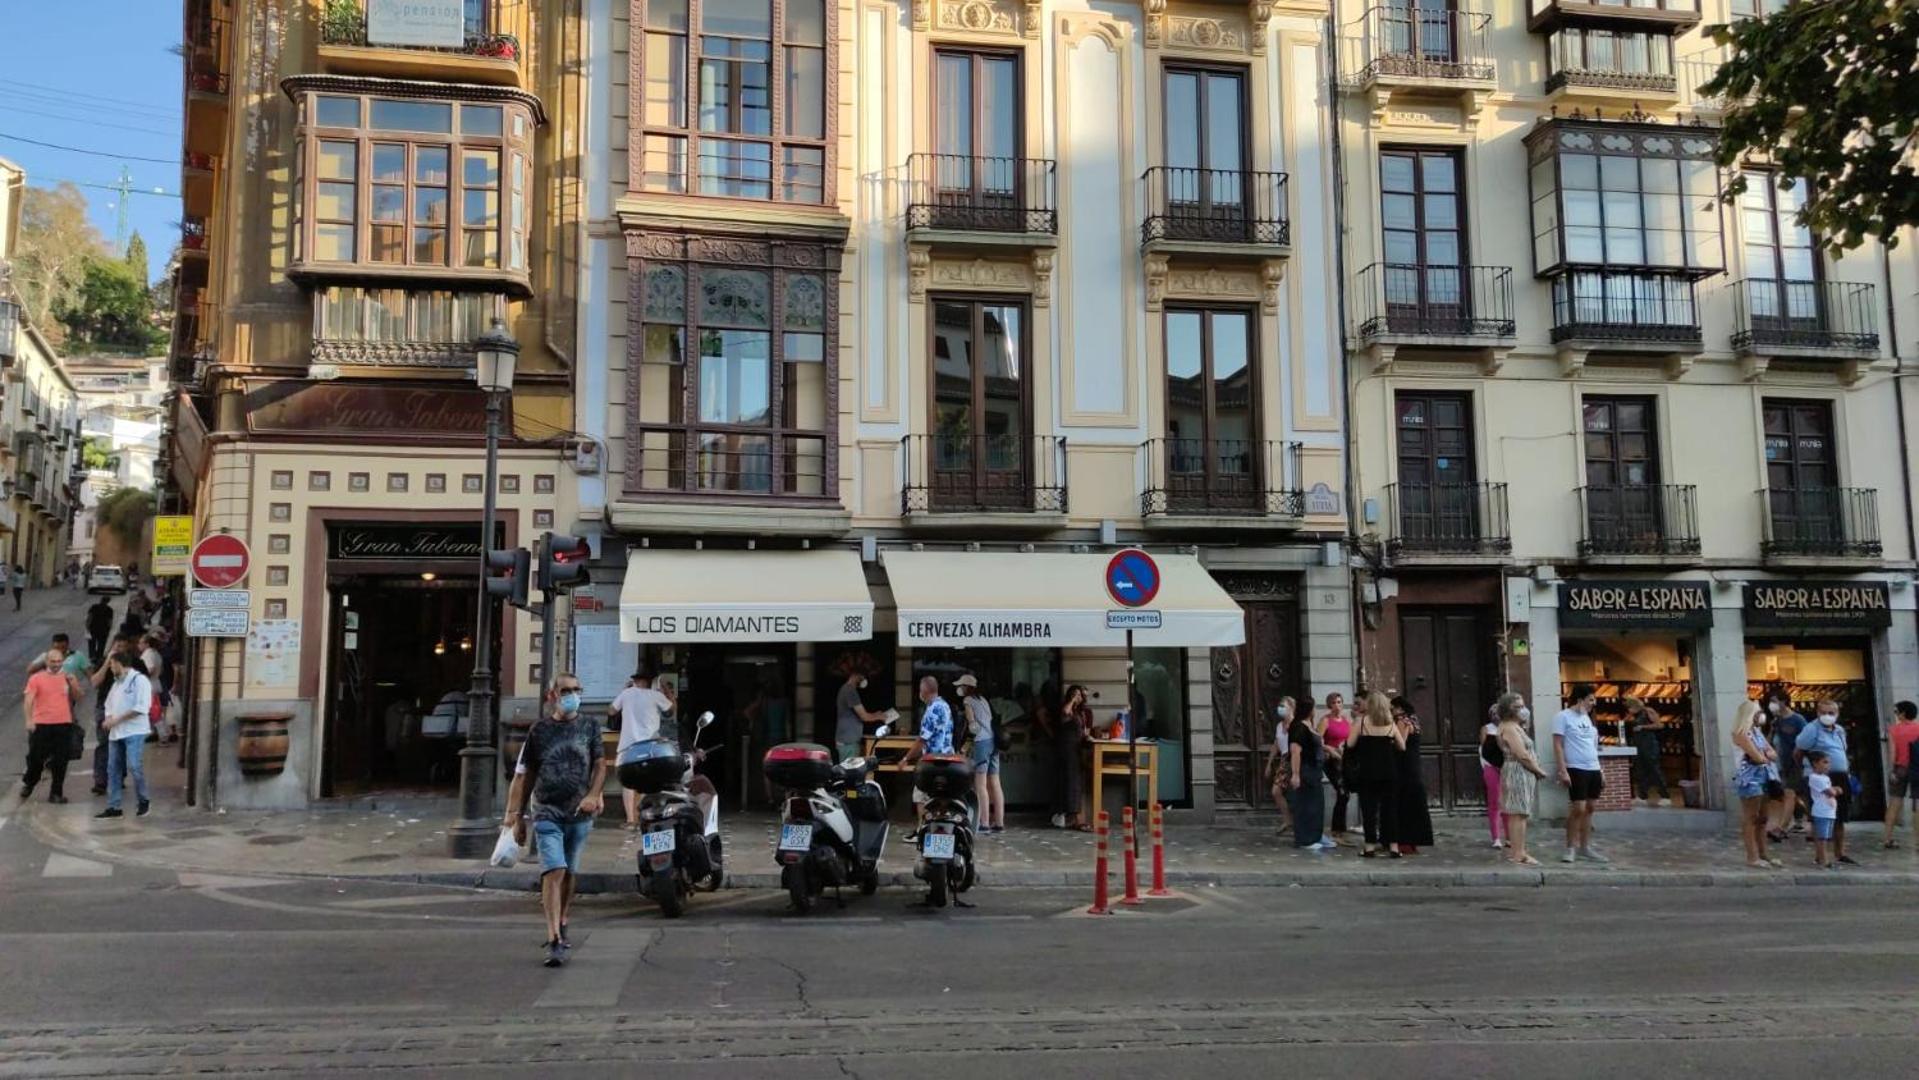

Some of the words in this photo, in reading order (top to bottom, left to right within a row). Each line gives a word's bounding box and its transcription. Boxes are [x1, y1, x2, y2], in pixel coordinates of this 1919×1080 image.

[325, 390, 393, 426] Gran
[400, 391, 488, 428] Tabern
[345, 531, 402, 553] Gran
[1570, 588, 1627, 610] SABOR
[1641, 588, 1707, 610] ESPAÑA
[1755, 588, 1809, 609] SABOR
[1823, 588, 1886, 609] ESPAÑA
[636, 616, 676, 633] LOS
[685, 616, 799, 633] DIAMANTES
[1137, 615, 1159, 623] MOTOS
[908, 622, 974, 638] CERVEZAS
[979, 622, 1052, 638] ALHAMBRA
